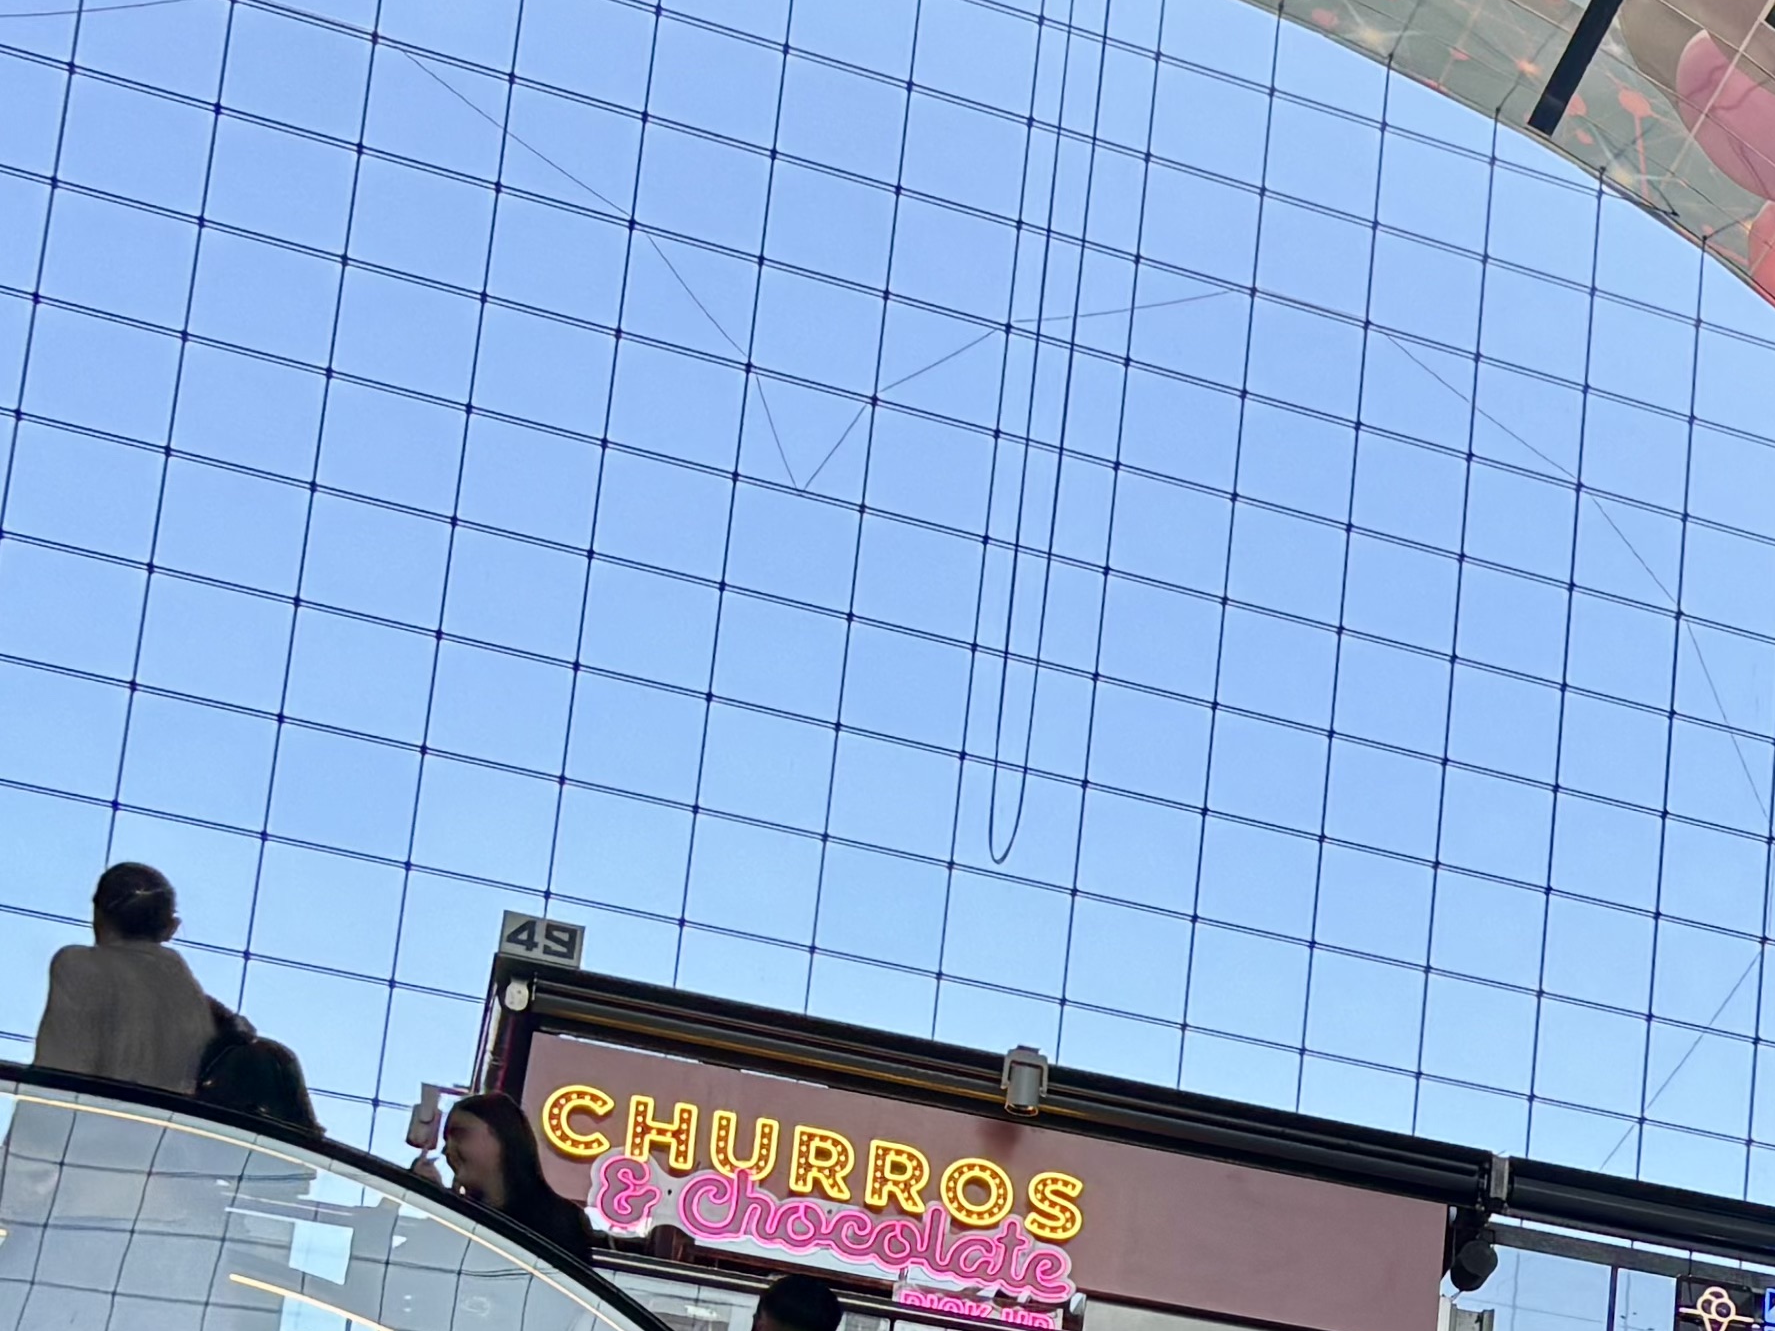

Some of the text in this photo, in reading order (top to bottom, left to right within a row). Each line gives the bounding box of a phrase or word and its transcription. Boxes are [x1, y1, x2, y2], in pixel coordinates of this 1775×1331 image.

[505, 920, 578, 957] 49
[542, 1084, 1085, 1241] CHURROS
[596, 1155, 1072, 1298] & Chocolate
